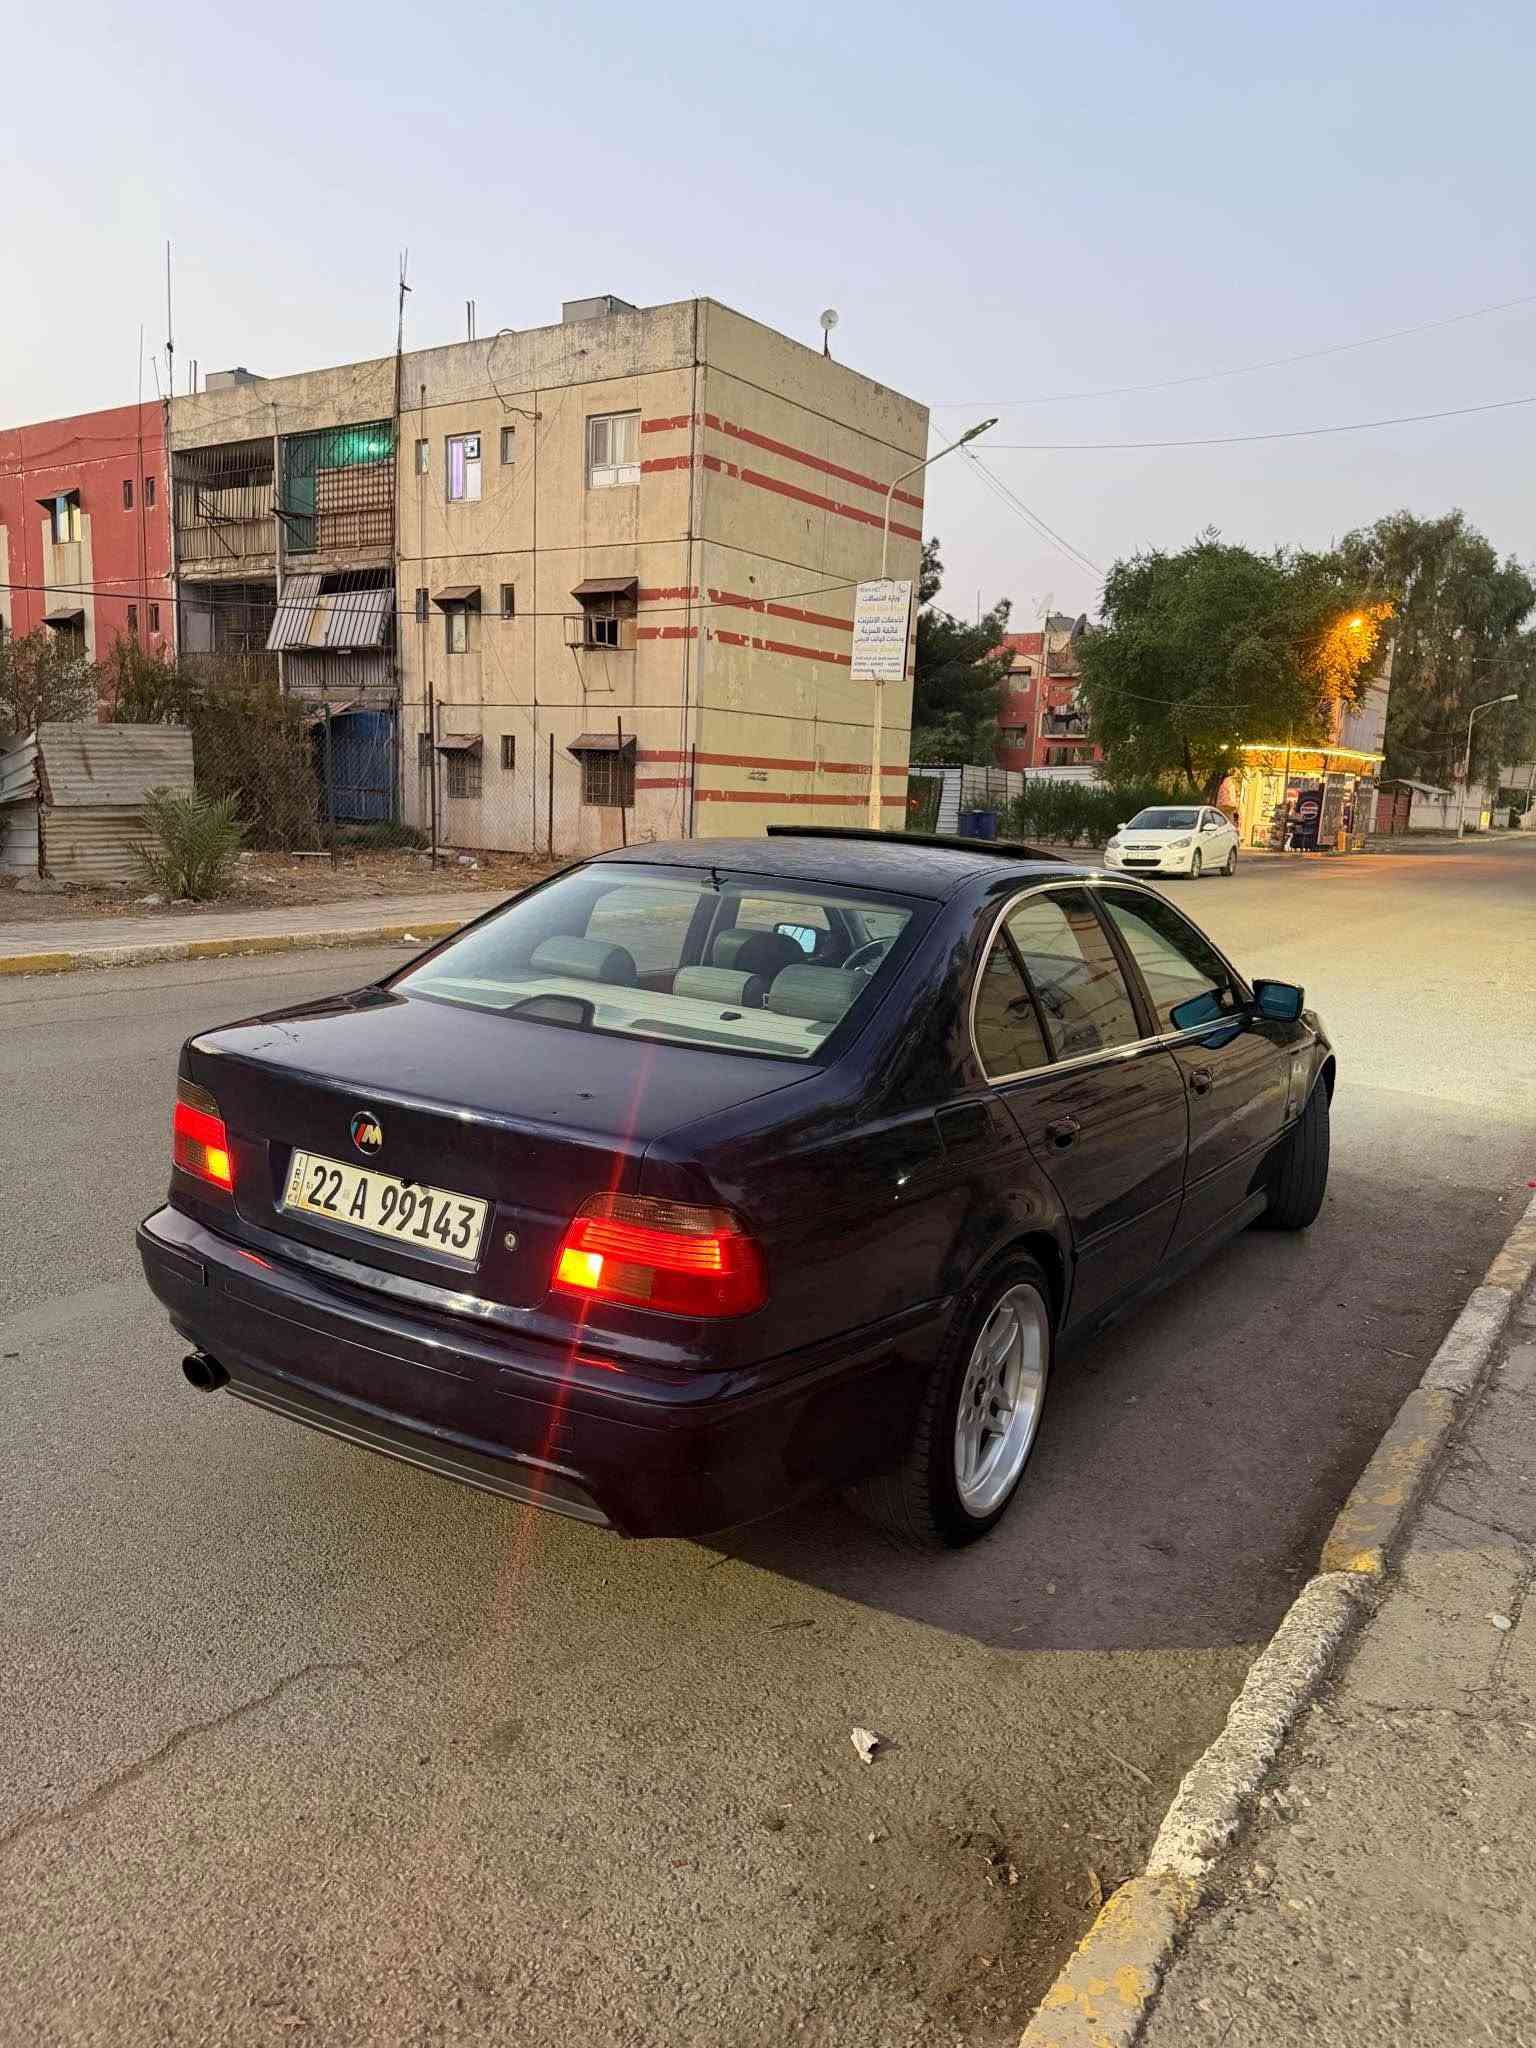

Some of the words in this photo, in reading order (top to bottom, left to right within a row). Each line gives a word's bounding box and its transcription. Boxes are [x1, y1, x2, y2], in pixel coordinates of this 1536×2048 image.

[307, 1165, 344, 1212] 22
[349, 1177, 368, 1220] A
[377, 1185, 476, 1249] 99143
